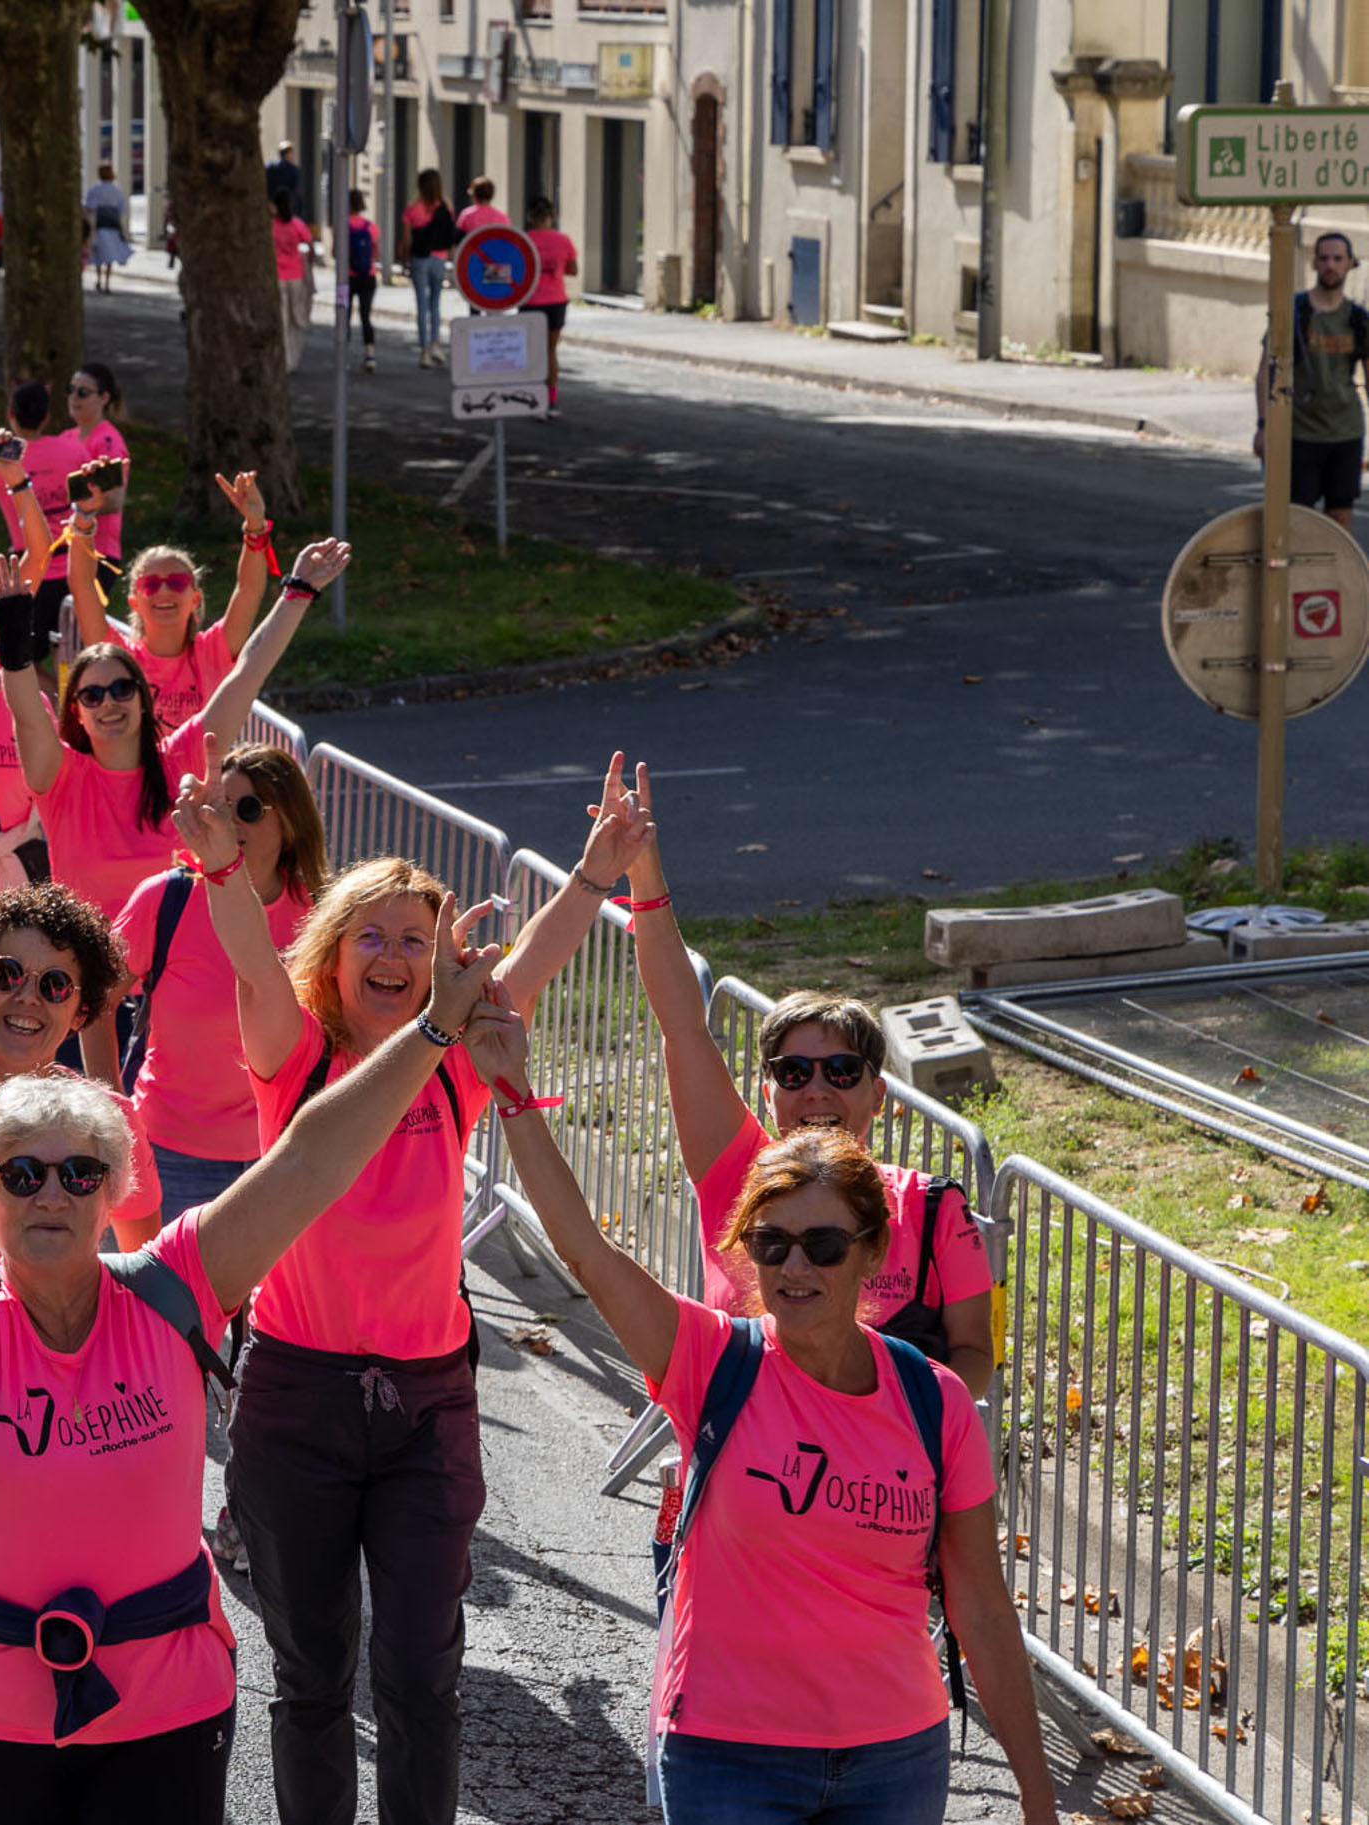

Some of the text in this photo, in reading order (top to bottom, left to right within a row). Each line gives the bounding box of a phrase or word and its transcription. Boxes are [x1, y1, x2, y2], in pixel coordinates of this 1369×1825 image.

[1256, 122, 1359, 152] Liberté
[1257, 159, 1298, 188] Val
[17, 1397, 32, 1421] LA
[101, 1422, 174, 1454] Roche-sur-Yon
[783, 1454, 801, 1480] LA
